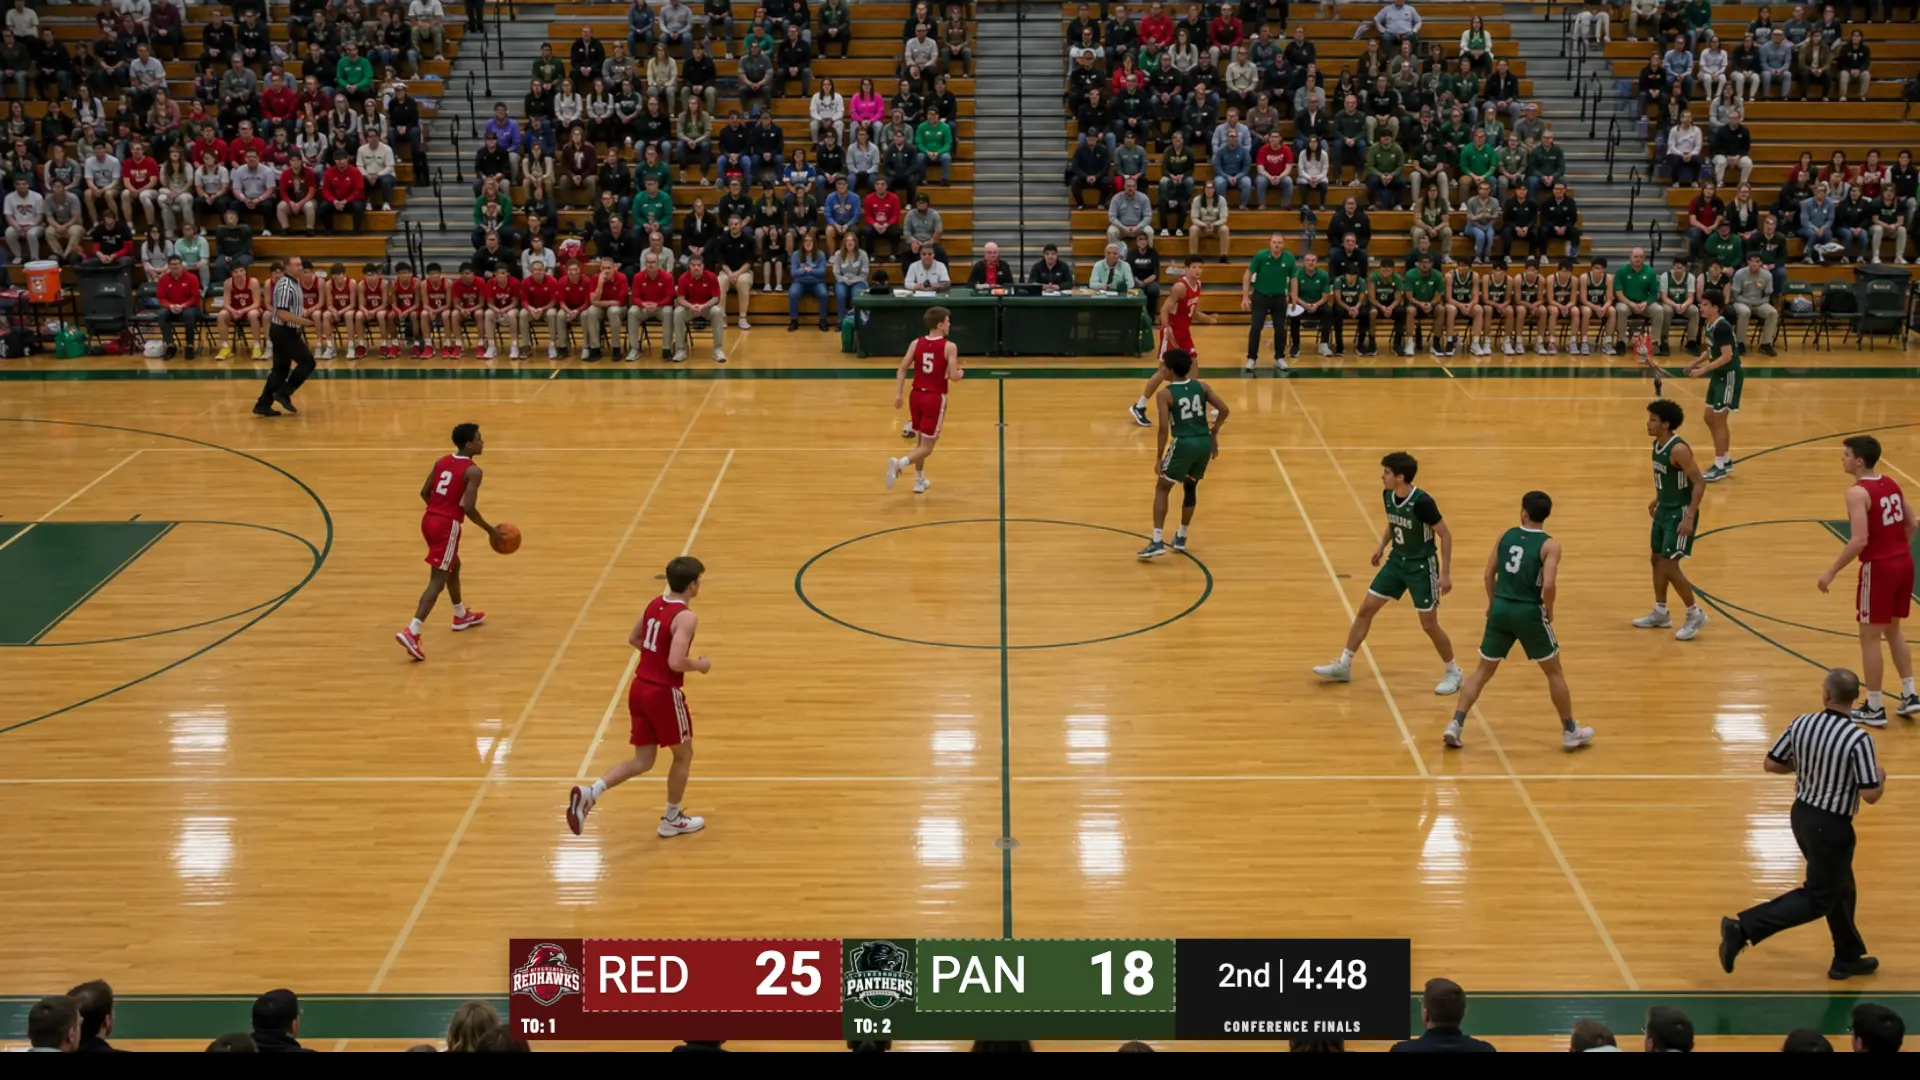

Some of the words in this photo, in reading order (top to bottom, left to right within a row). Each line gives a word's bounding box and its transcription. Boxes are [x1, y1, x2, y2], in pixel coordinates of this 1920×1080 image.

[922, 352, 935, 374] 5
[1178, 394, 1204, 420] 24
[435, 470, 453, 496] 2
[1879, 493, 1904, 526] 23
[1505, 545, 1524, 574] 3
[642, 617, 661, 653] 11
